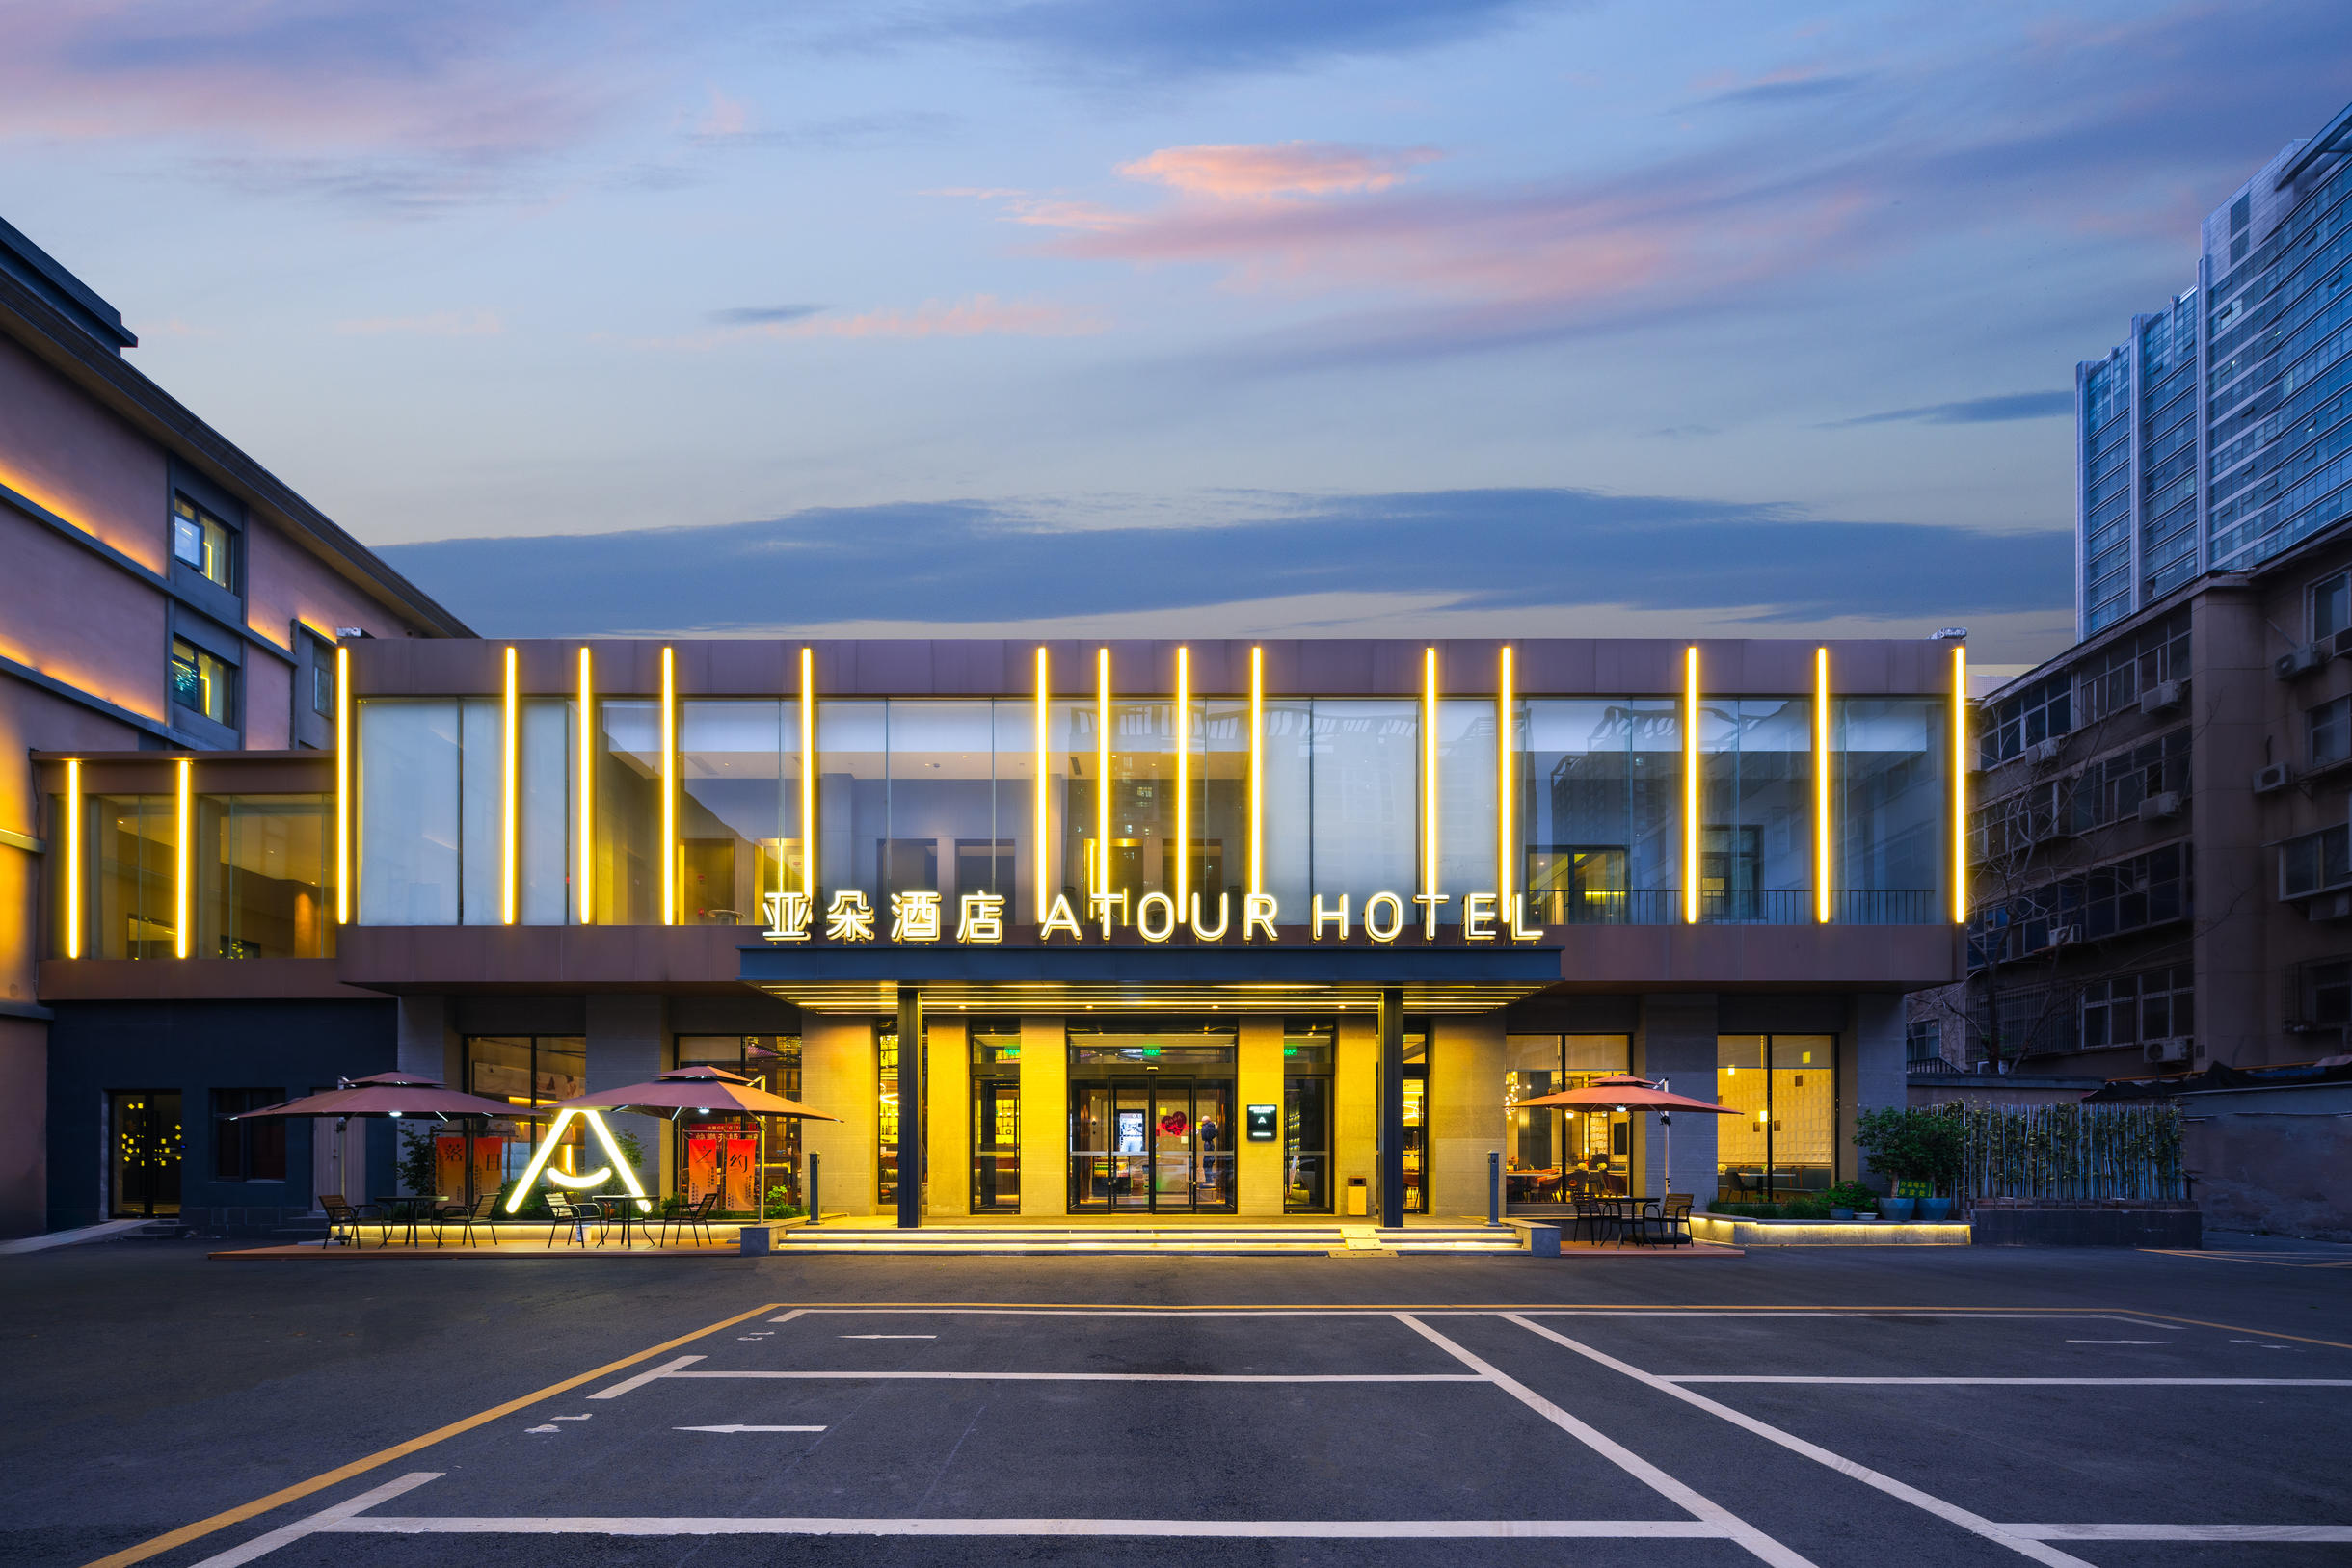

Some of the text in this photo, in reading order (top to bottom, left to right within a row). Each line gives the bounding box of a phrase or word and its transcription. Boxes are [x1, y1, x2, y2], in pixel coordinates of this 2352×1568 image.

[762, 890, 1544, 943] 亚朵酒店 ATOUR HOTEL
[729, 1153, 748, 1174] 约
